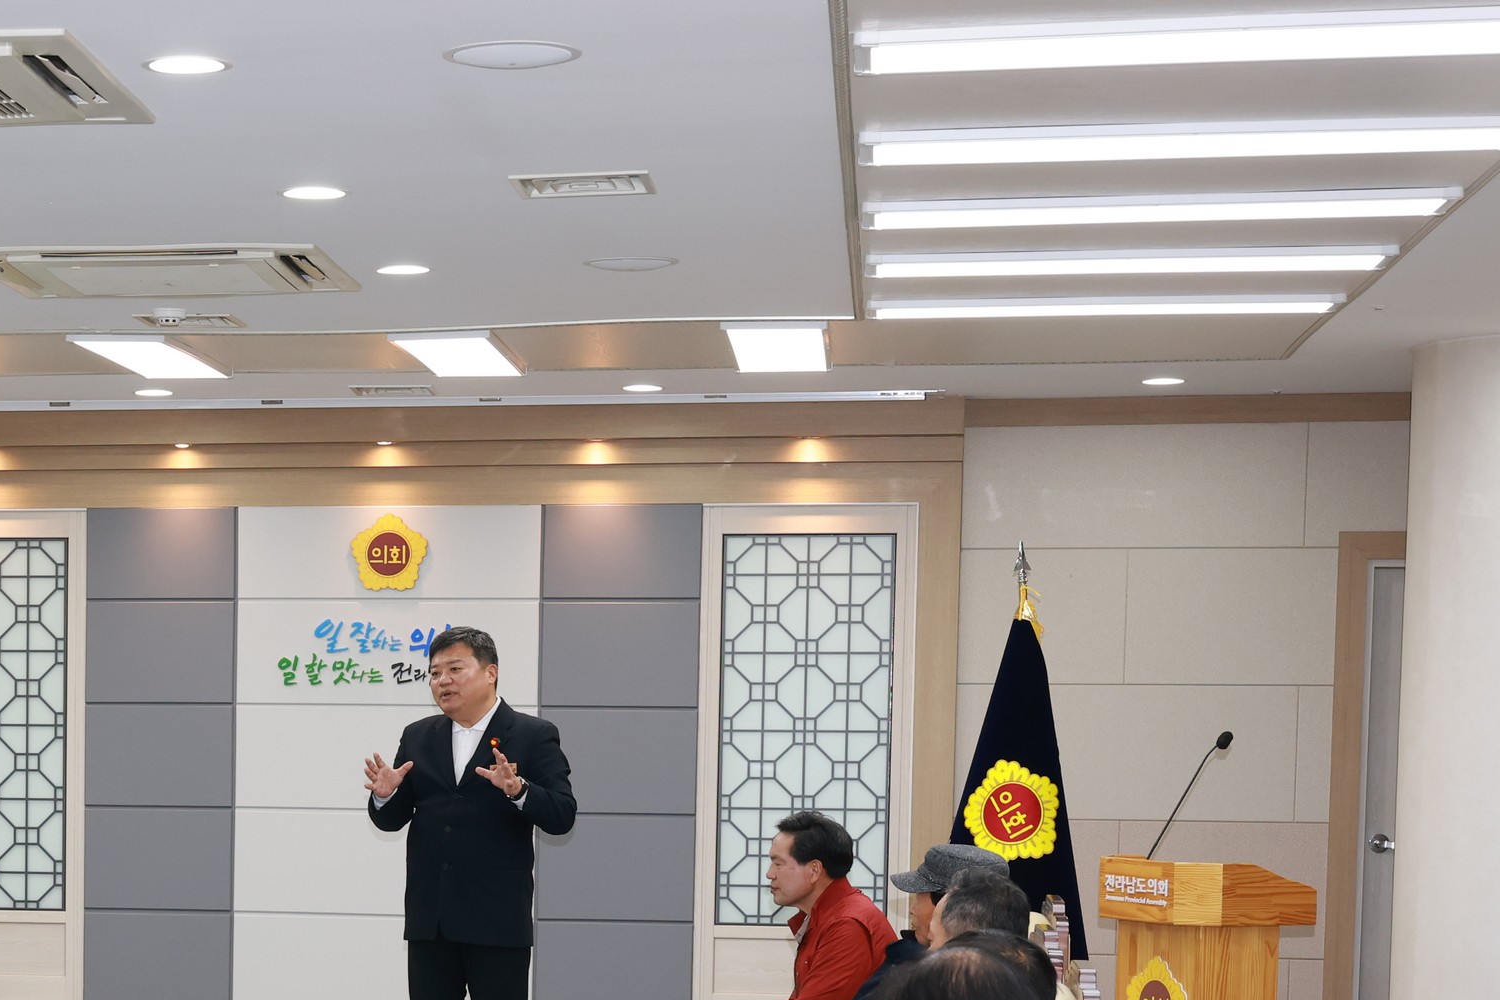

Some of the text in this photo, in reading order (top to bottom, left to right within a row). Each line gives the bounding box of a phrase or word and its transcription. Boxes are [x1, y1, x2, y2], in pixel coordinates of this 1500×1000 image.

[369, 544, 406, 565] 의회
[314, 618, 349, 653] 일
[349, 621, 403, 653] 잘하는
[988, 791, 1034, 839] 의회
[1104, 874, 1169, 897] 전라남도의회
